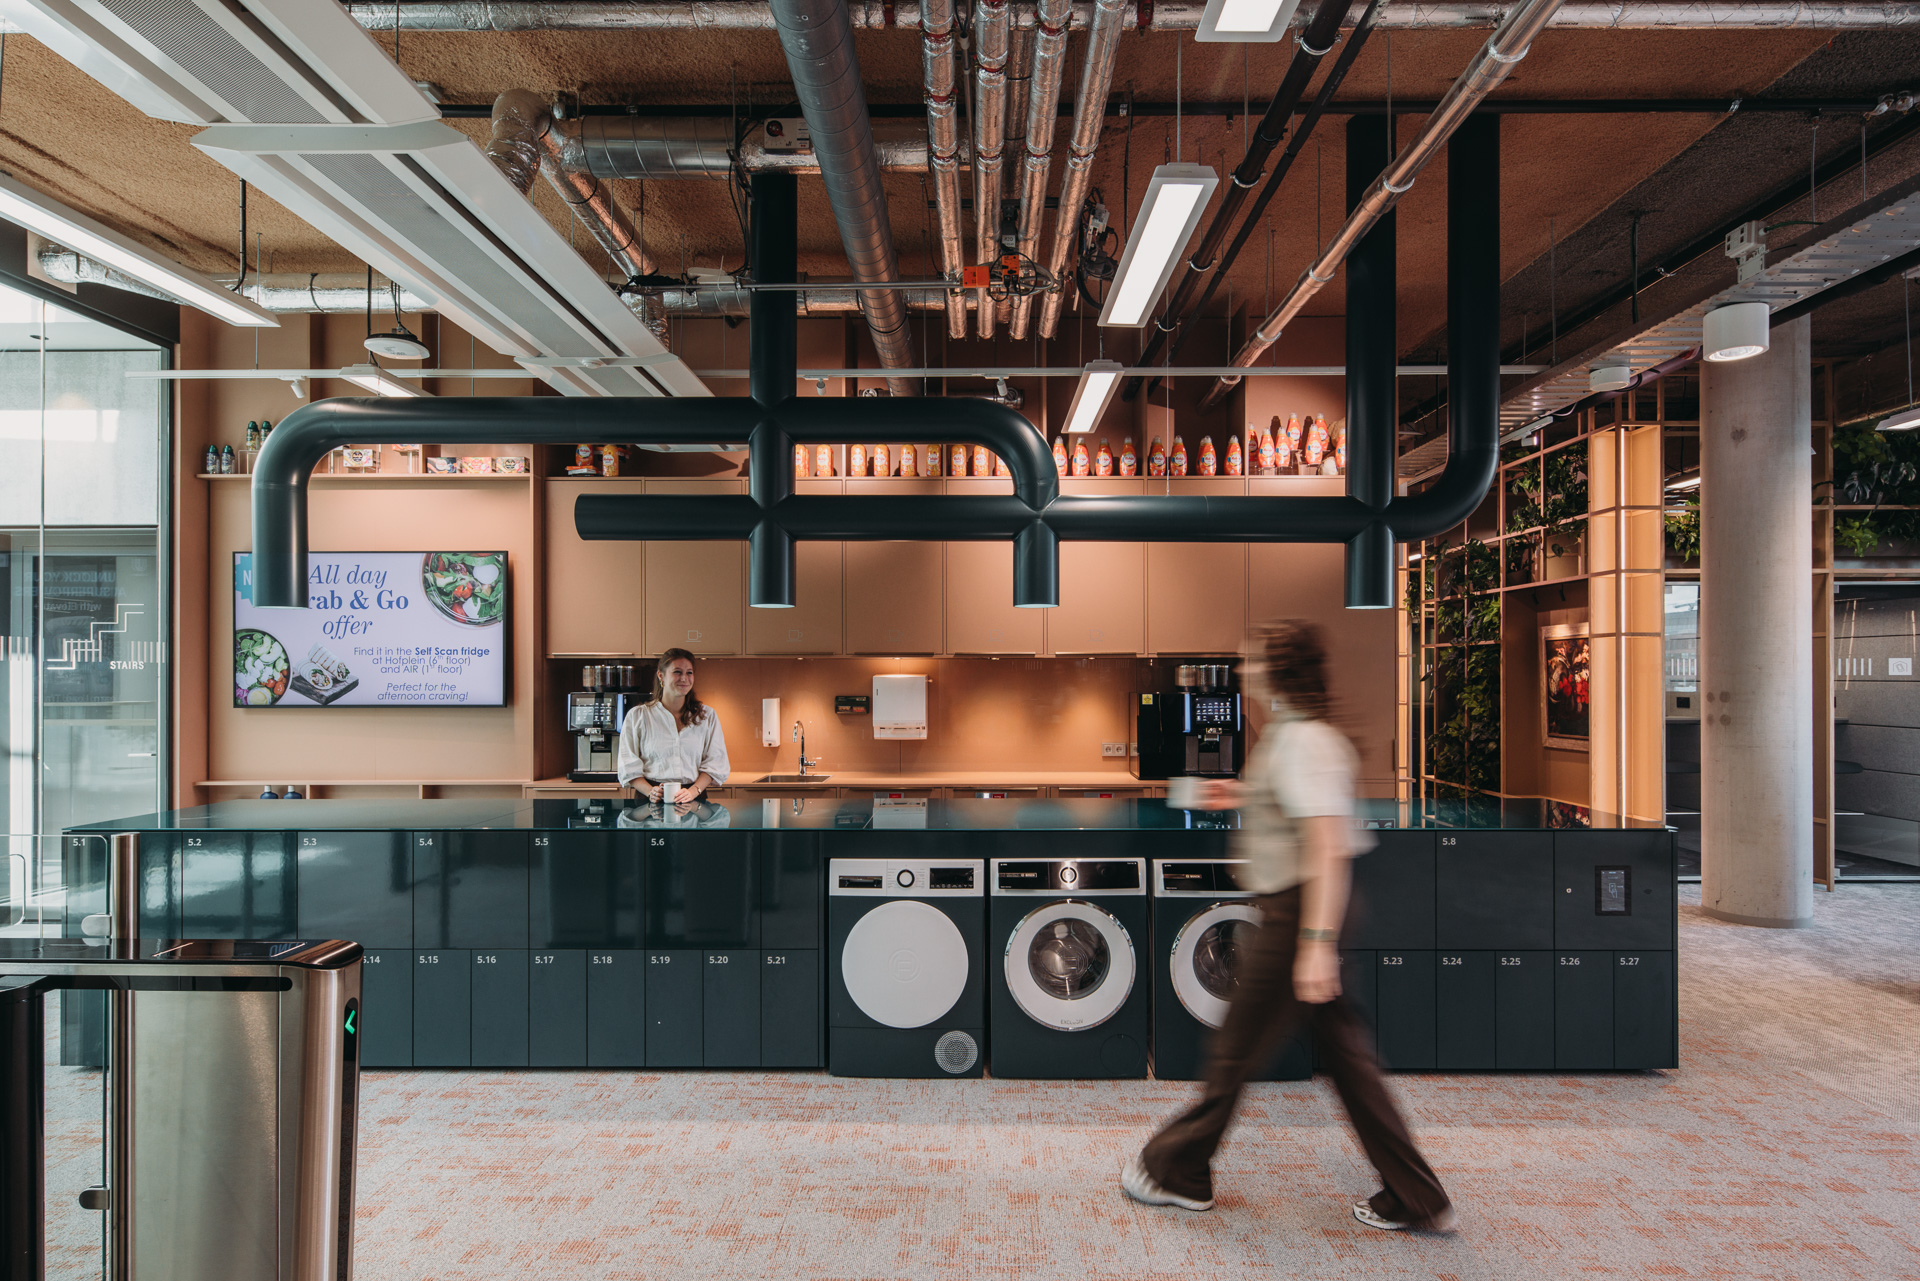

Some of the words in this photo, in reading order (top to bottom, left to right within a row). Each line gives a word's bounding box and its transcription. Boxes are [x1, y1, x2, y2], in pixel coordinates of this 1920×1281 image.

[308, 564, 341, 584] All
[346, 564, 387, 590] day
[308, 589, 343, 610] rab
[350, 589, 370, 610] &
[376, 589, 409, 610] Go
[322, 614, 374, 640] offer
[353, 647, 374, 656] Find
[376, 647, 383, 656] it
[384, 647, 395, 656] in
[396, 647, 412, 656] the
[414, 647, 432, 656] Self
[434, 647, 459, 656] Scan
[461, 647, 490, 658] fridge
[109, 660, 145, 670] STAIRS
[372, 657, 383, 665] at
[385, 656, 426, 666] Hofplein
[446, 656, 471, 667] floor)
[380, 665, 400, 674] and
[402, 665, 419, 674] AIR
[437, 665, 463, 675] floor)
[386, 682, 422, 692] Perfect
[424, 682, 438, 692] for
[440, 682, 457, 692] the
[377, 691, 426, 701] afternoon
[428, 692, 469, 702] craving!
[73, 838, 87, 847] 5.1
[188, 838, 202, 847] 5.2
[303, 838, 317, 847] 5.3
[419, 838, 433, 847] 5.4
[535, 837, 549, 846] 5.5
[650, 837, 665, 846] 5.6
[1442, 837, 1457, 846] 5.8
[363, 955, 381, 964] 5.14
[419, 955, 439, 964] 5.15
[477, 955, 497, 964] 5.16
[535, 955, 554, 964] 5.17
[593, 955, 613, 964] 5.18
[650, 955, 671, 964] 5.19
[709, 955, 729, 964] 5.20
[767, 956, 786, 965] 5.21
[1383, 956, 1403, 966] 5.23
[1442, 957, 1463, 966] 5.24
[1501, 957, 1521, 966] 5.25
[1560, 957, 1581, 966] 5.26
[1620, 957, 1640, 966] 5.27
